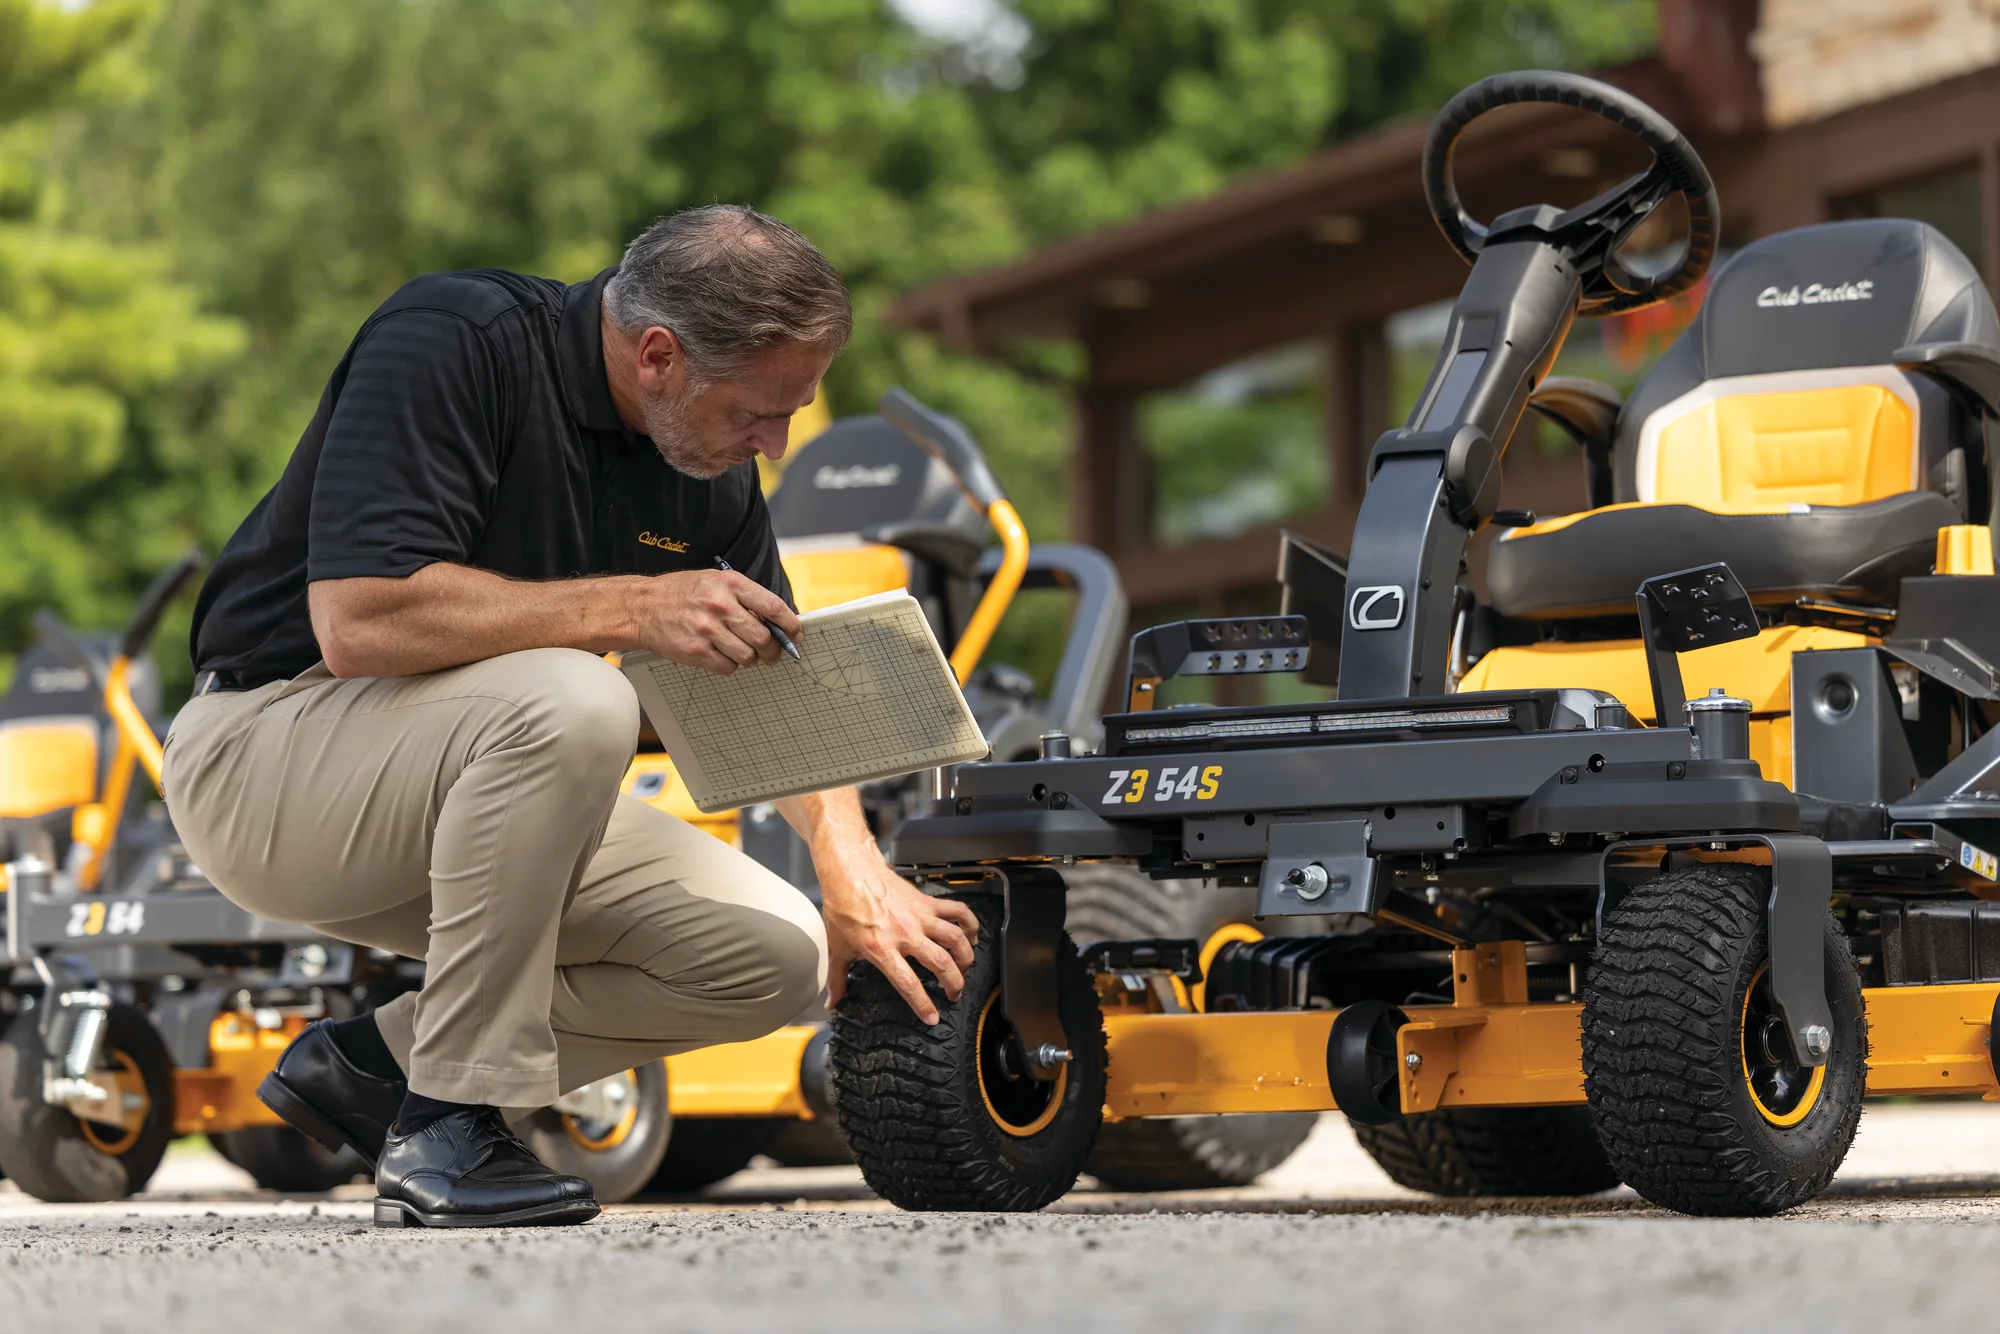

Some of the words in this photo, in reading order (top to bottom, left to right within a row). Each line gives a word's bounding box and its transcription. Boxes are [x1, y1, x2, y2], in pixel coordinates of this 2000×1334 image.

[1757, 285, 1799, 307] Cub
[1802, 279, 1874, 304] Cadet
[638, 531, 658, 546] Cub
[657, 537, 691, 553] Cadet
[1101, 769, 1149, 804] Z3
[1154, 765, 1223, 802] 54S
